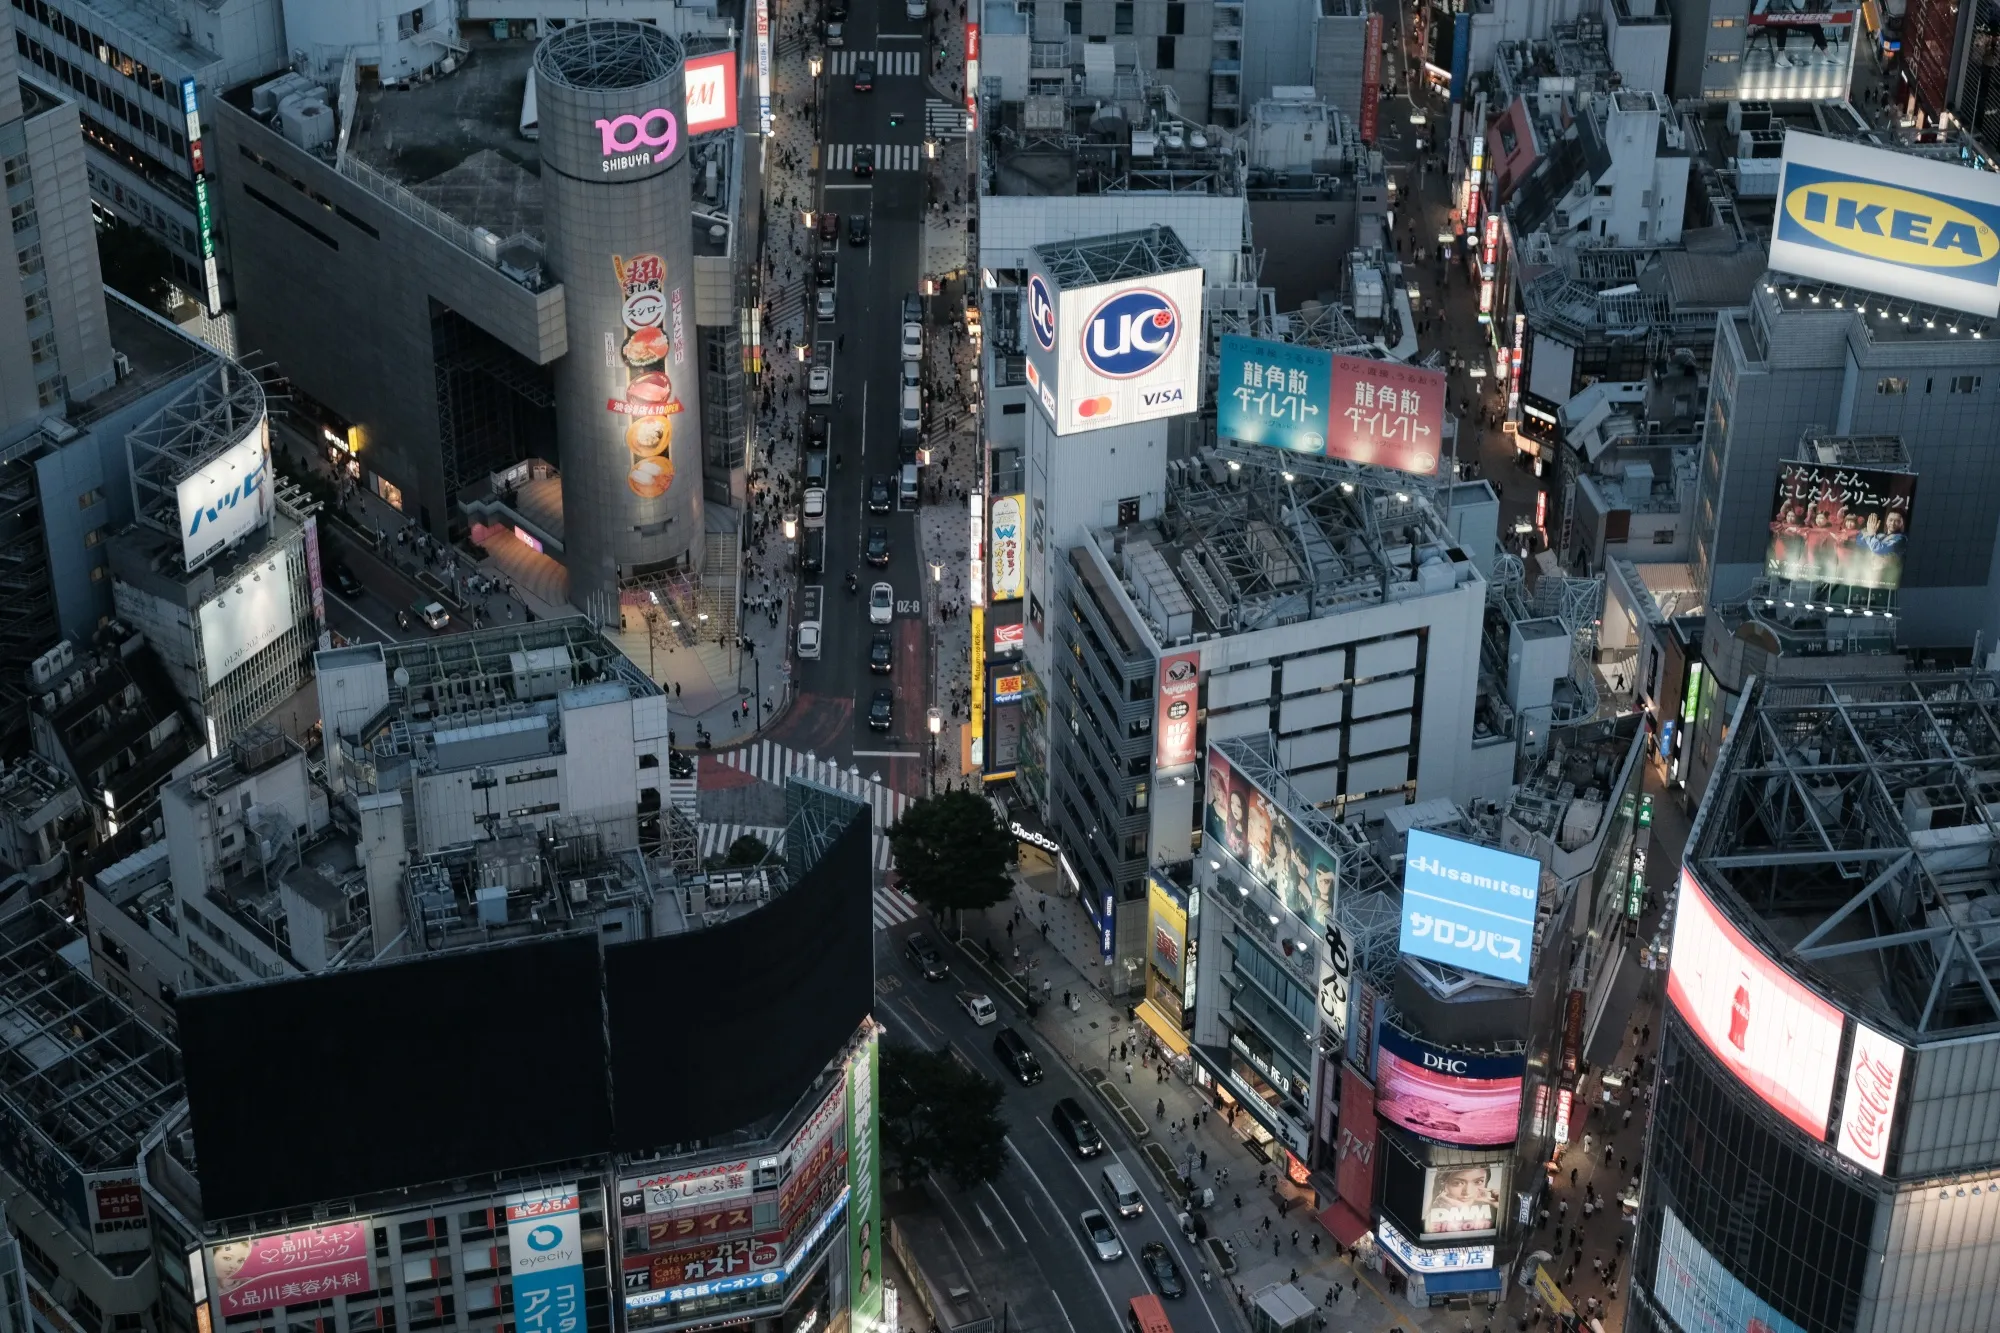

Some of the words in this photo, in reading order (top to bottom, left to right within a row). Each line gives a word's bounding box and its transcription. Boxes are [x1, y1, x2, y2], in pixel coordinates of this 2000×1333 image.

[757, 9, 769, 36] LABI
[1767, 13, 1833, 22] SKECHERS
[760, 43, 769, 77] SHIBUYA
[595, 108, 677, 163] 109
[602, 152, 650, 172] SHIBUYA
[196, 184, 213, 252] ビリヤード・ダーツ
[1804, 191, 1983, 258] IKEA
[625, 256, 663, 284] 超
[627, 279, 661, 295] すし祭
[628, 304, 664, 318] スシロー
[1243, 360, 1309, 396] 龍角散
[664, 403, 679, 414] OPEN
[1043, 393, 1055, 412] VISA
[1143, 388, 1184, 406] VISA
[1232, 386, 1320, 423] ダイレクト
[1354, 380, 1420, 416] 龍角散
[1343, 409, 1431, 443] ダイレクト
[995, 524, 1017, 540] W
[896, 600, 920, 614] 8-20
[974, 649, 983, 682] Matsumoto
[1011, 821, 1061, 852] グルメタウン
[1408, 856, 1534, 900] Hisamitsu
[1156, 925, 1179, 967] 薬
[1409, 911, 1523, 964] サロンパス
[1423, 1052, 1468, 1074] DHC
[1418, 1135, 1431, 1145] DHC
[1432, 1138, 1459, 1150] Channel
[637, 1161, 748, 1188] しゃぶしゃぶバイキング
[681, 1173, 745, 1199] しゃぶ葉
[101, 1195, 139, 1206] エスパス
[622, 1194, 643, 1206] 9F
[1430, 1204, 1492, 1222] DMM
[650, 1210, 750, 1242] プライス
[281, 1230, 357, 1254] 品川スキン
[716, 1238, 764, 1259] ガスト
[1384, 1232, 1486, 1268] 大盛堂書店
[283, 1244, 350, 1265] クリニック
[519, 1249, 574, 1267] eyecity
[755, 1252, 776, 1264] ガスト
[626, 1272, 649, 1288] 7F
[655, 1265, 681, 1278] Café
[655, 1275, 681, 1285] レストラン
[684, 1256, 744, 1280] ガスト
[241, 1271, 361, 1306] 品川美容外科
[670, 1271, 758, 1301] 英会話イーオン
[522, 1288, 553, 1333] アイ
